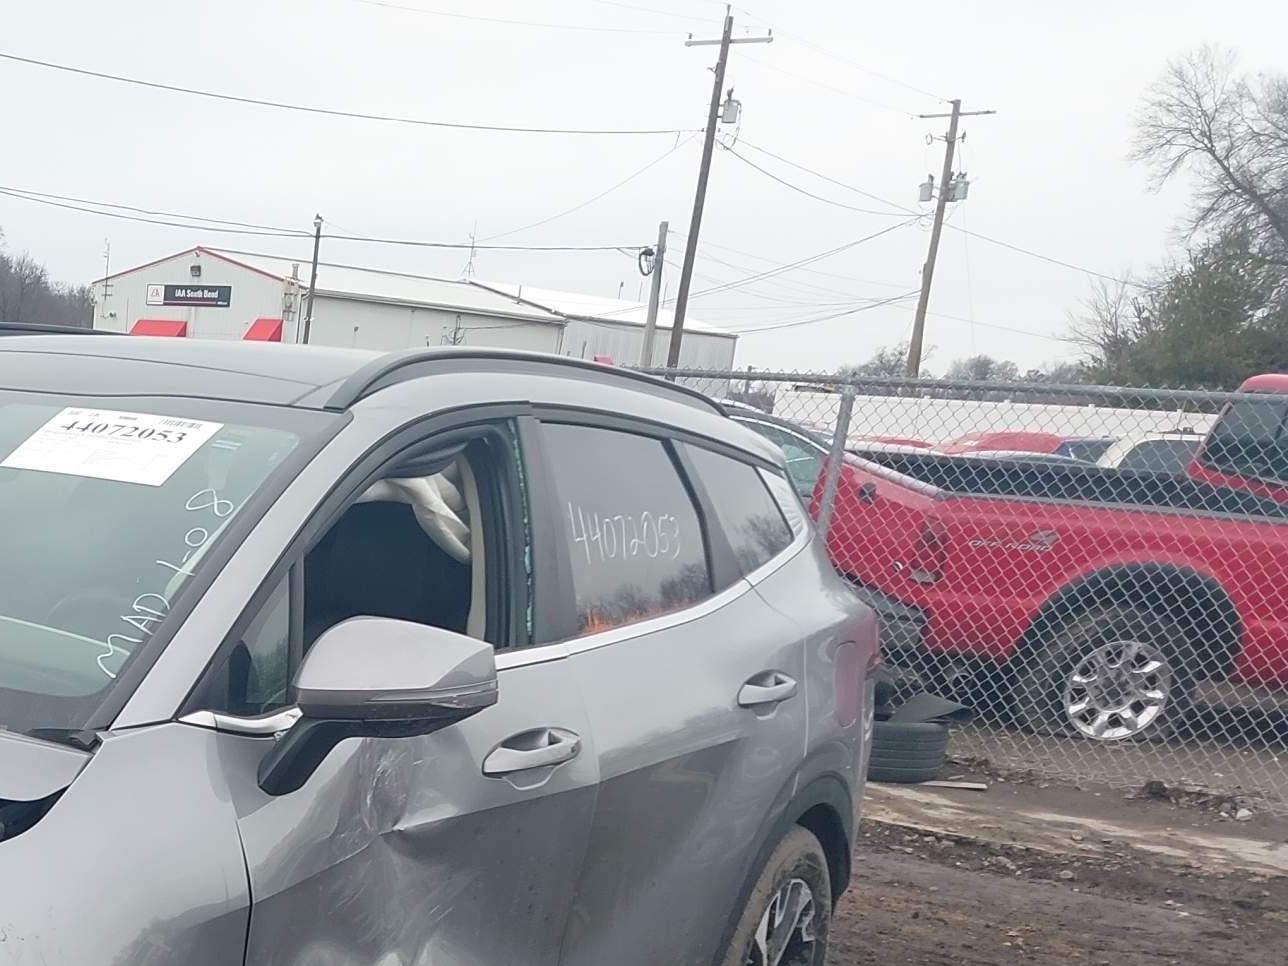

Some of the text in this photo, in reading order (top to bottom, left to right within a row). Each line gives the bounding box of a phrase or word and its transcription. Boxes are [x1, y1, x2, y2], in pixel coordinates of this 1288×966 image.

[175, 289, 219, 298] IAA South Bend
[61, 420, 189, 444] 44072053
[568, 500, 681, 566] 44072053
